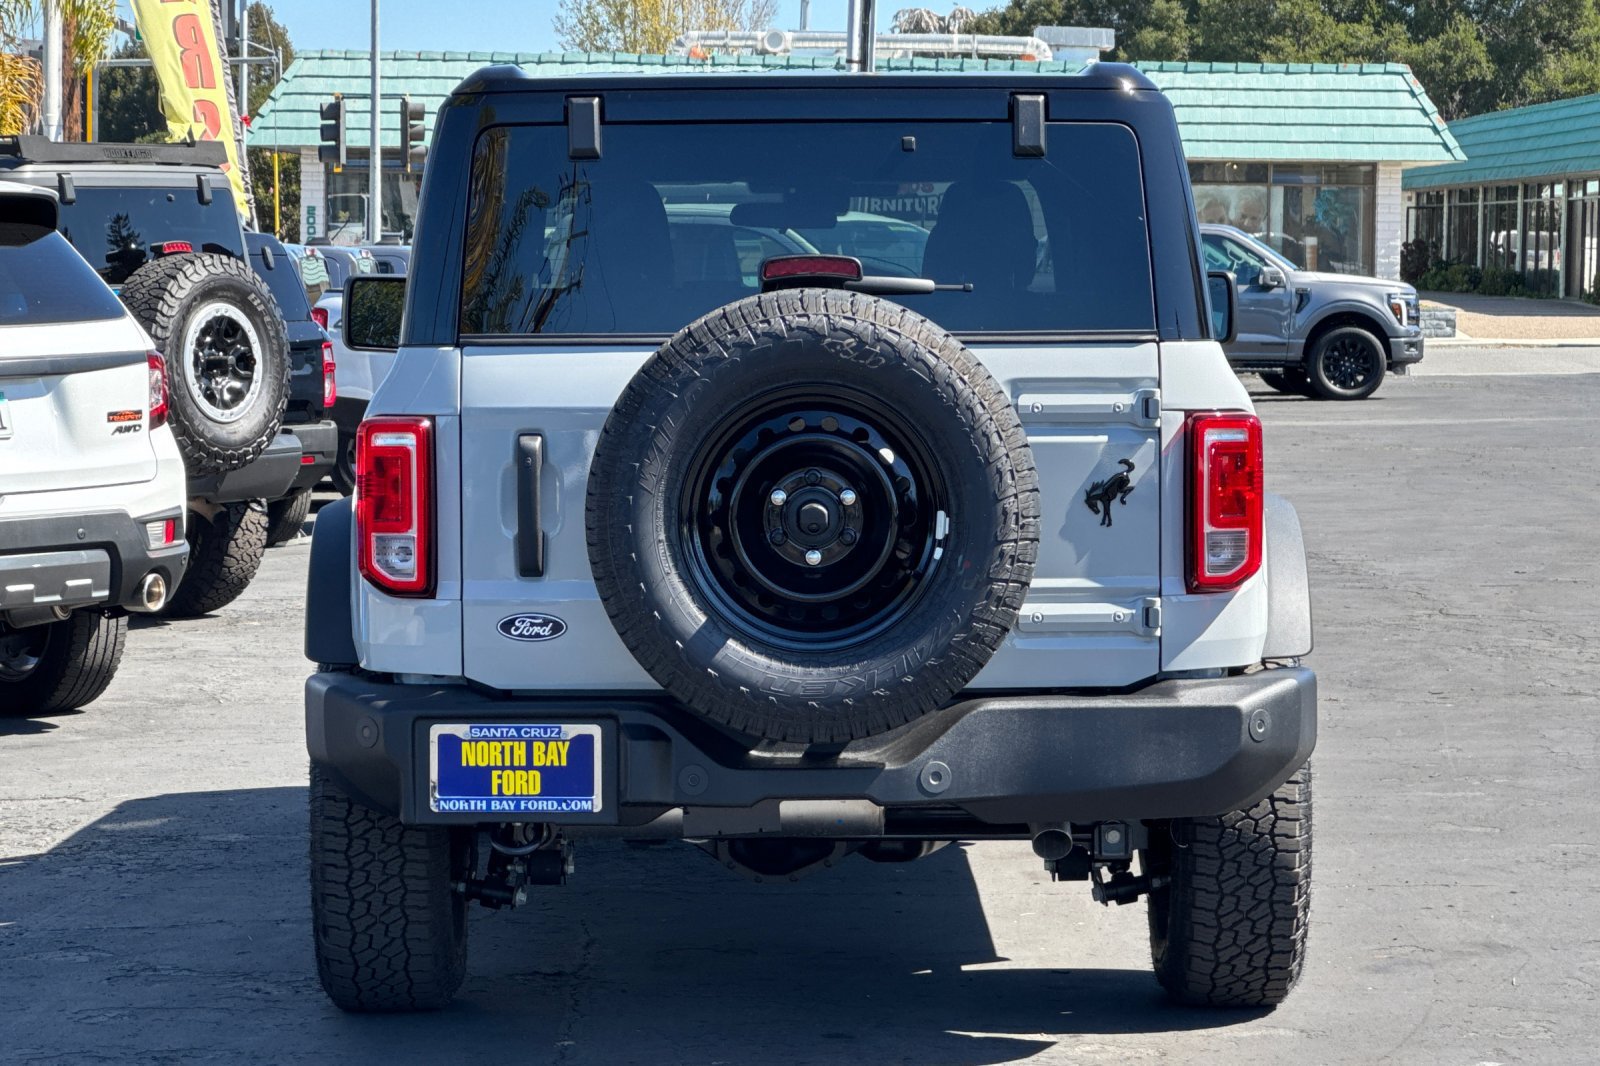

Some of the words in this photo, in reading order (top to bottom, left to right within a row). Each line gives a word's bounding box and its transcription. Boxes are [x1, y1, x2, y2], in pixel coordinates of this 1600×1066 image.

[111, 424, 142, 435] AWD
[510, 617, 553, 636] Ford
[471, 728, 518, 738] SANTA
[521, 728, 560, 738] CRUZ
[461, 741, 526, 767] NORTH
[533, 741, 570, 767] BAY
[491, 770, 541, 796] FORD
[439, 799, 487, 811] NORTH
[491, 799, 517, 811] BAY
[521, 799, 592, 811] FORD.COM
